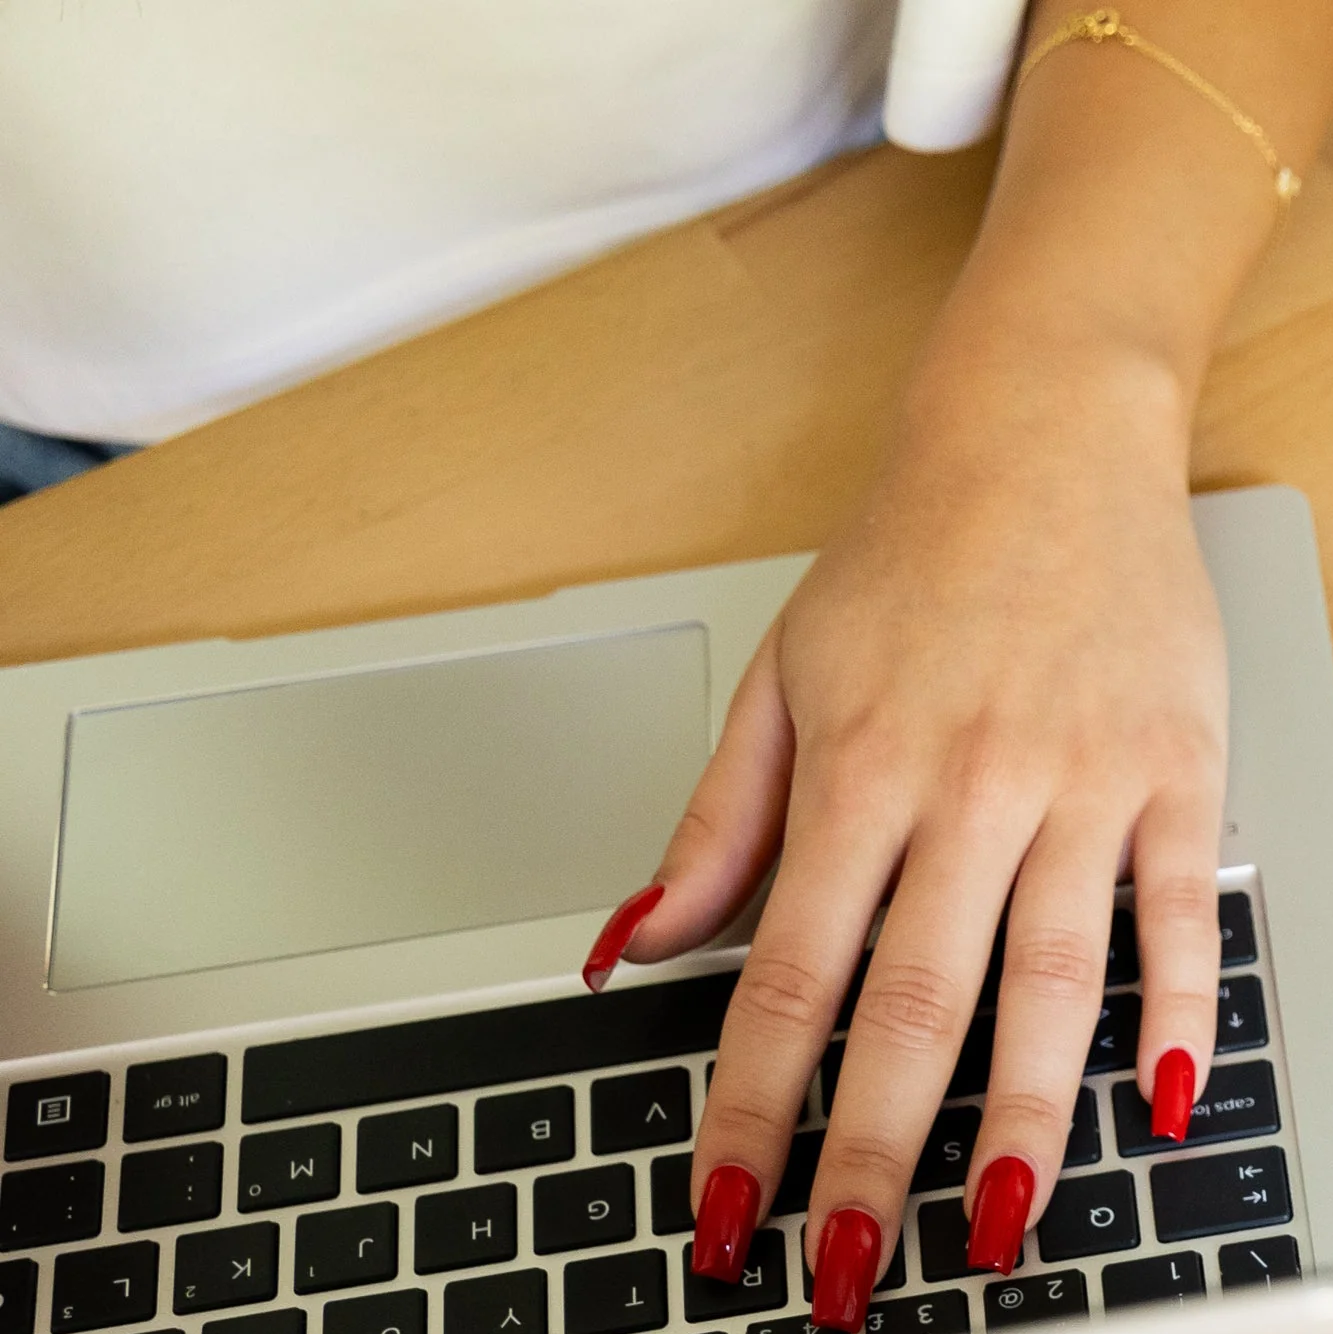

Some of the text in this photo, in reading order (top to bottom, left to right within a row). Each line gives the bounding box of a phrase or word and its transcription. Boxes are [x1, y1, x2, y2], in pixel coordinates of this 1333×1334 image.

[152, 1092, 201, 1111] alt gr
[645, 1101, 668, 1123] V
[1189, 1097, 1256, 1118] caps lo
[530, 1118, 551, 1140] B
[411, 1138, 434, 1161] N
[943, 1140, 962, 1161] S
[290, 1157, 314, 1180] M
[586, 1199, 611, 1221] G
[1089, 1206, 1116, 1228] Q
[470, 1218, 493, 1241] H
[358, 1237, 375, 1259] J
[231, 1257, 251, 1280] K
[308, 1265, 315, 1278] 1
[742, 1266, 763, 1287] R
[1170, 1261, 1181, 1281] 1
[112, 1277, 131, 1298] L
[184, 1284, 197, 1298] 2
[623, 1285, 644, 1308] T
[998, 1279, 1064, 1309] 2 @
[62, 1305, 75, 1319] 3
[500, 1307, 523, 1329] Y
[867, 1304, 934, 1331] 3 £
